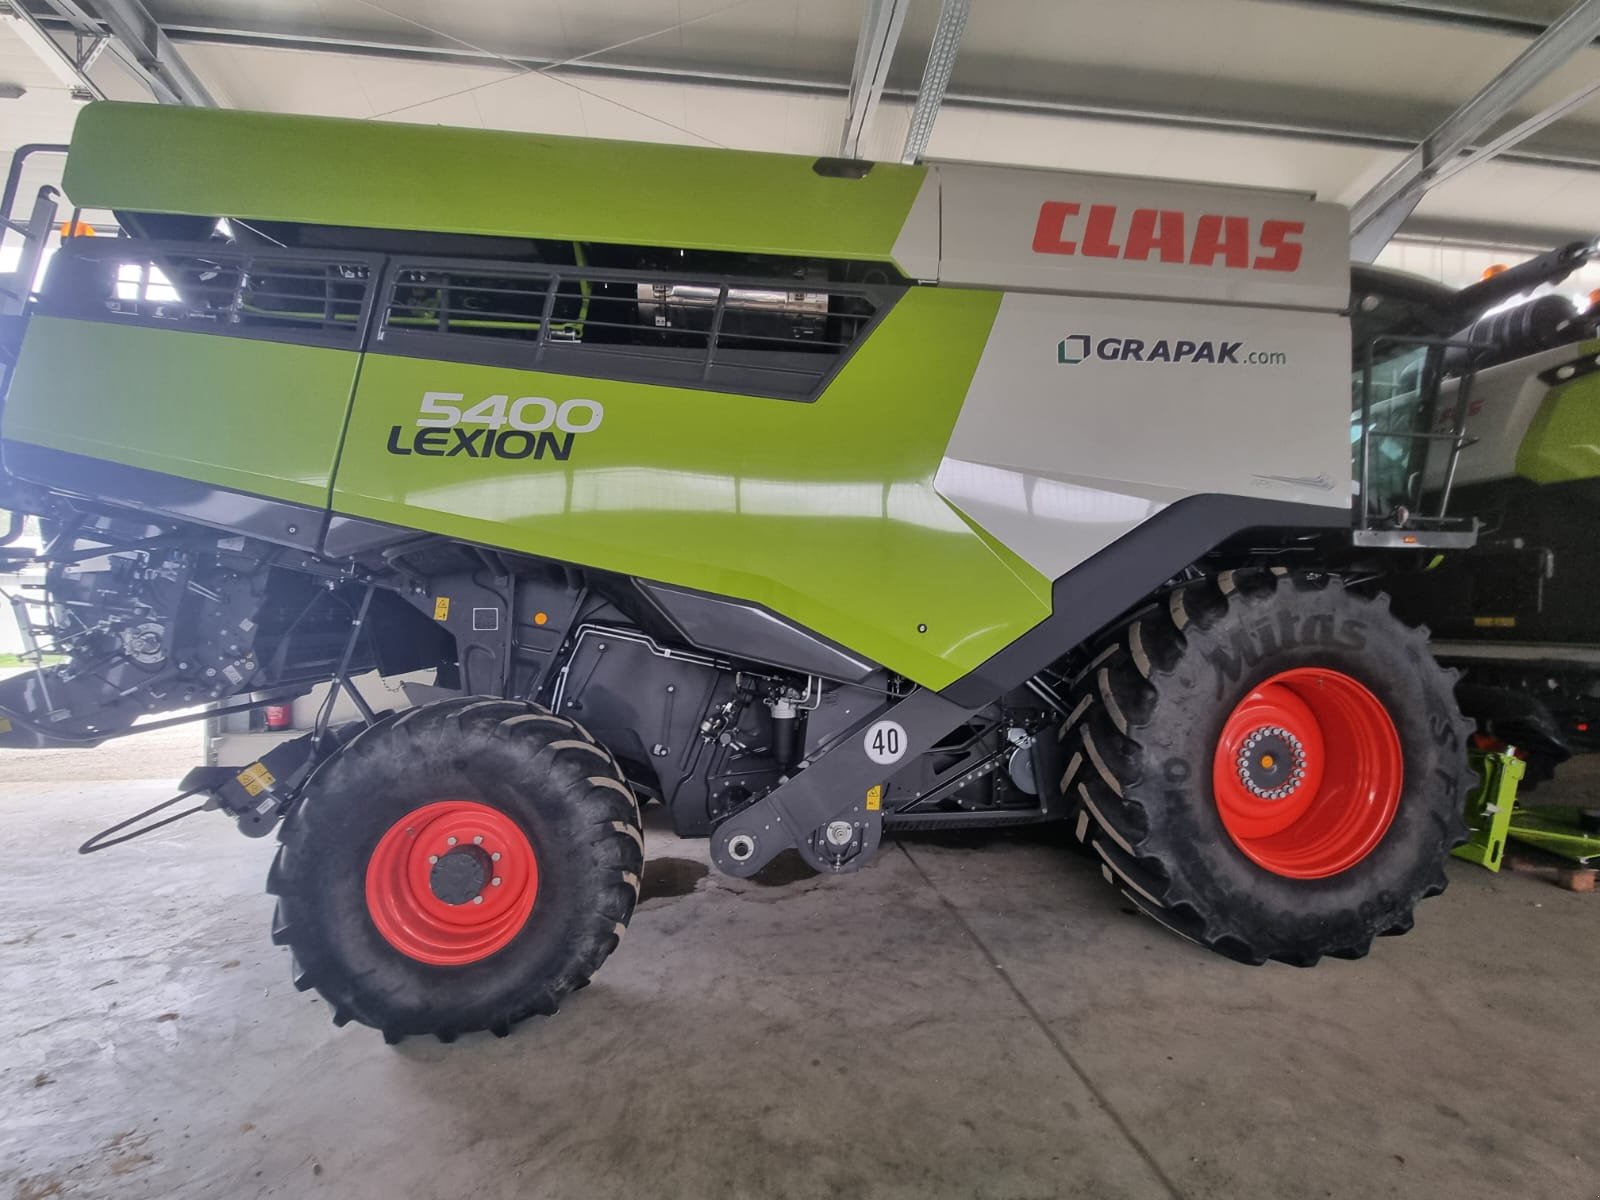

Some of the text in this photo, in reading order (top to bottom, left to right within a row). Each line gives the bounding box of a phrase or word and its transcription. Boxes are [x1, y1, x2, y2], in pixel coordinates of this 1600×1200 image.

[1032, 201, 1305, 272] CLAAS
[1096, 337, 1287, 365] GRAPAK.com
[416, 391, 604, 433] 5400
[387, 425, 576, 461] LEXION
[1202, 608, 1367, 700] Mitas
[872, 728, 899, 755] 40
